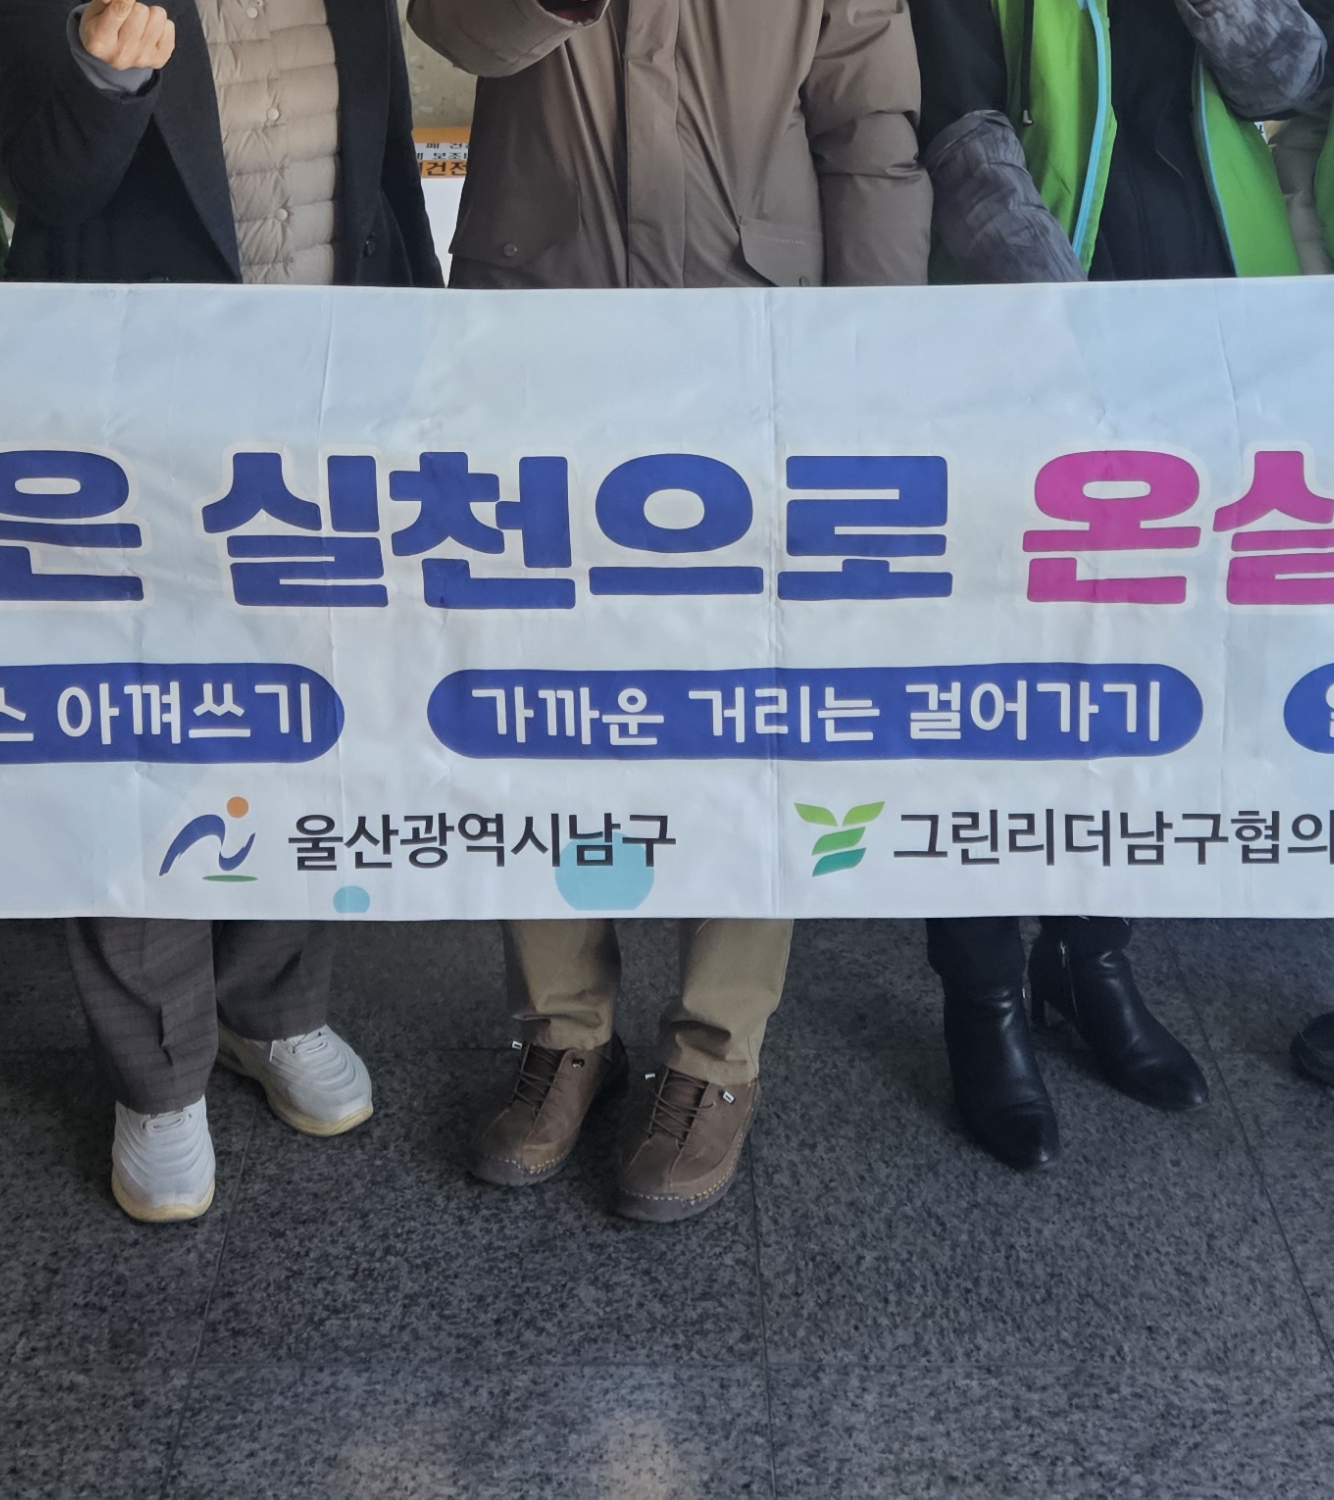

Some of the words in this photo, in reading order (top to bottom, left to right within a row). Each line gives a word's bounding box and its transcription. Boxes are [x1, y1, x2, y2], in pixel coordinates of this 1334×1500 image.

[201, 451, 955, 610] 실천으로
[56, 679, 314, 747] 아껴쓰기
[471, 684, 666, 748] 가까운
[687, 683, 882, 746] 거리는
[904, 679, 1162, 743] 걸어가기
[287, 810, 678, 873] 울산광역시남구
